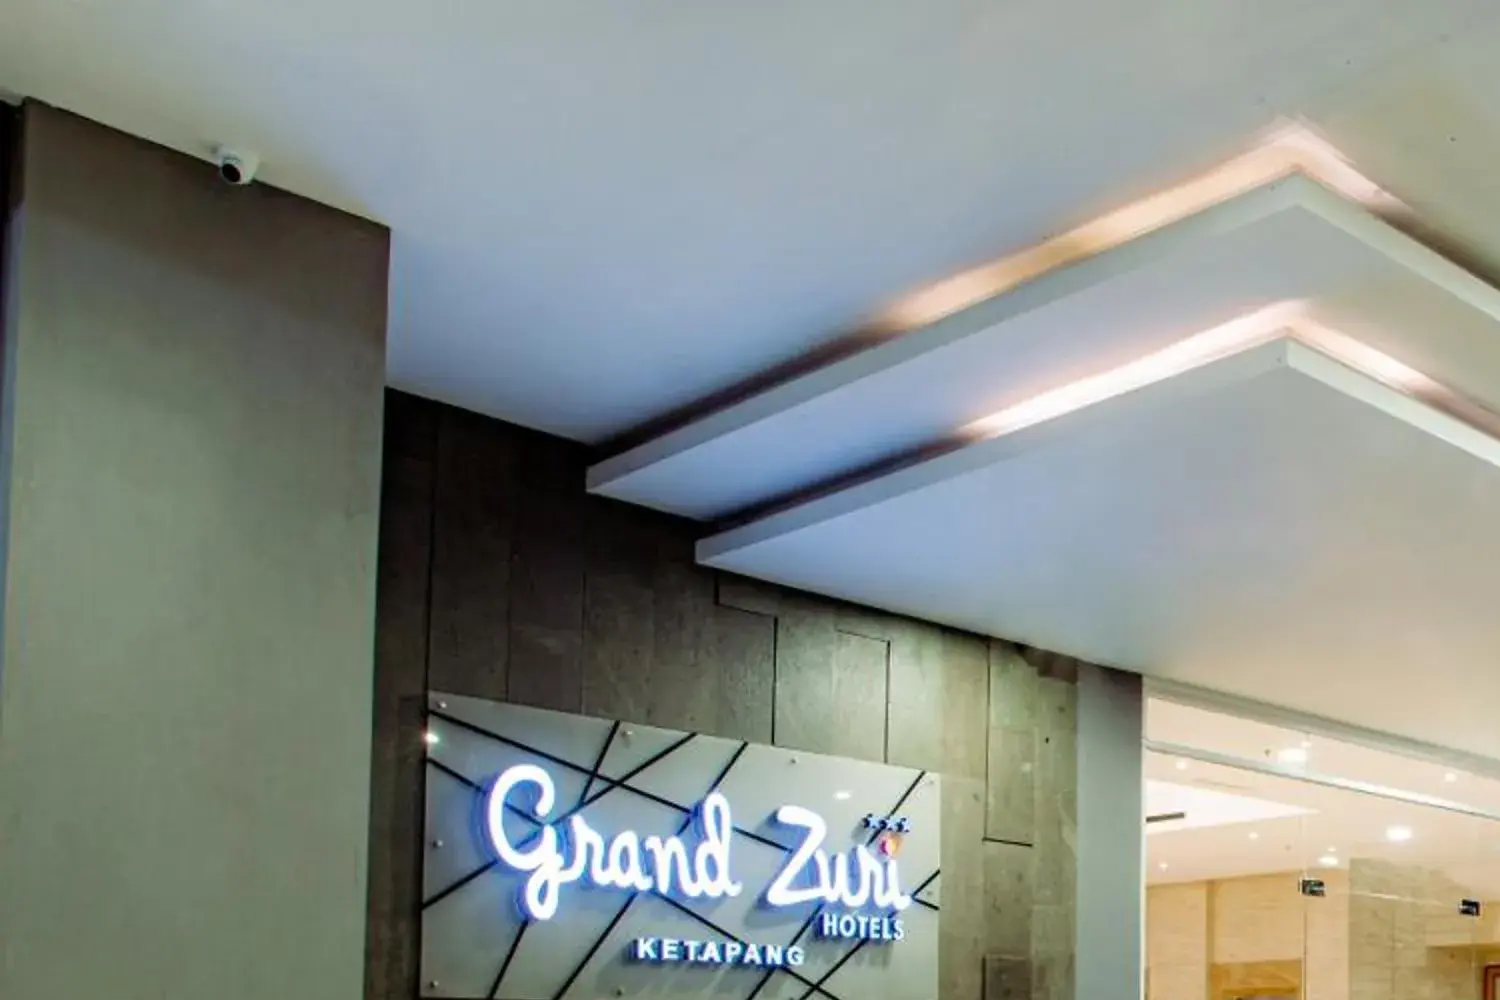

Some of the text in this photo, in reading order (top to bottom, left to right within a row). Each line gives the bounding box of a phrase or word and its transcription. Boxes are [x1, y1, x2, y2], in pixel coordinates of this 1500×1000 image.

[489, 765, 912, 920] Grand Zuri
[823, 912, 905, 941] HOTELS
[636, 936, 805, 966] KETAPANG
